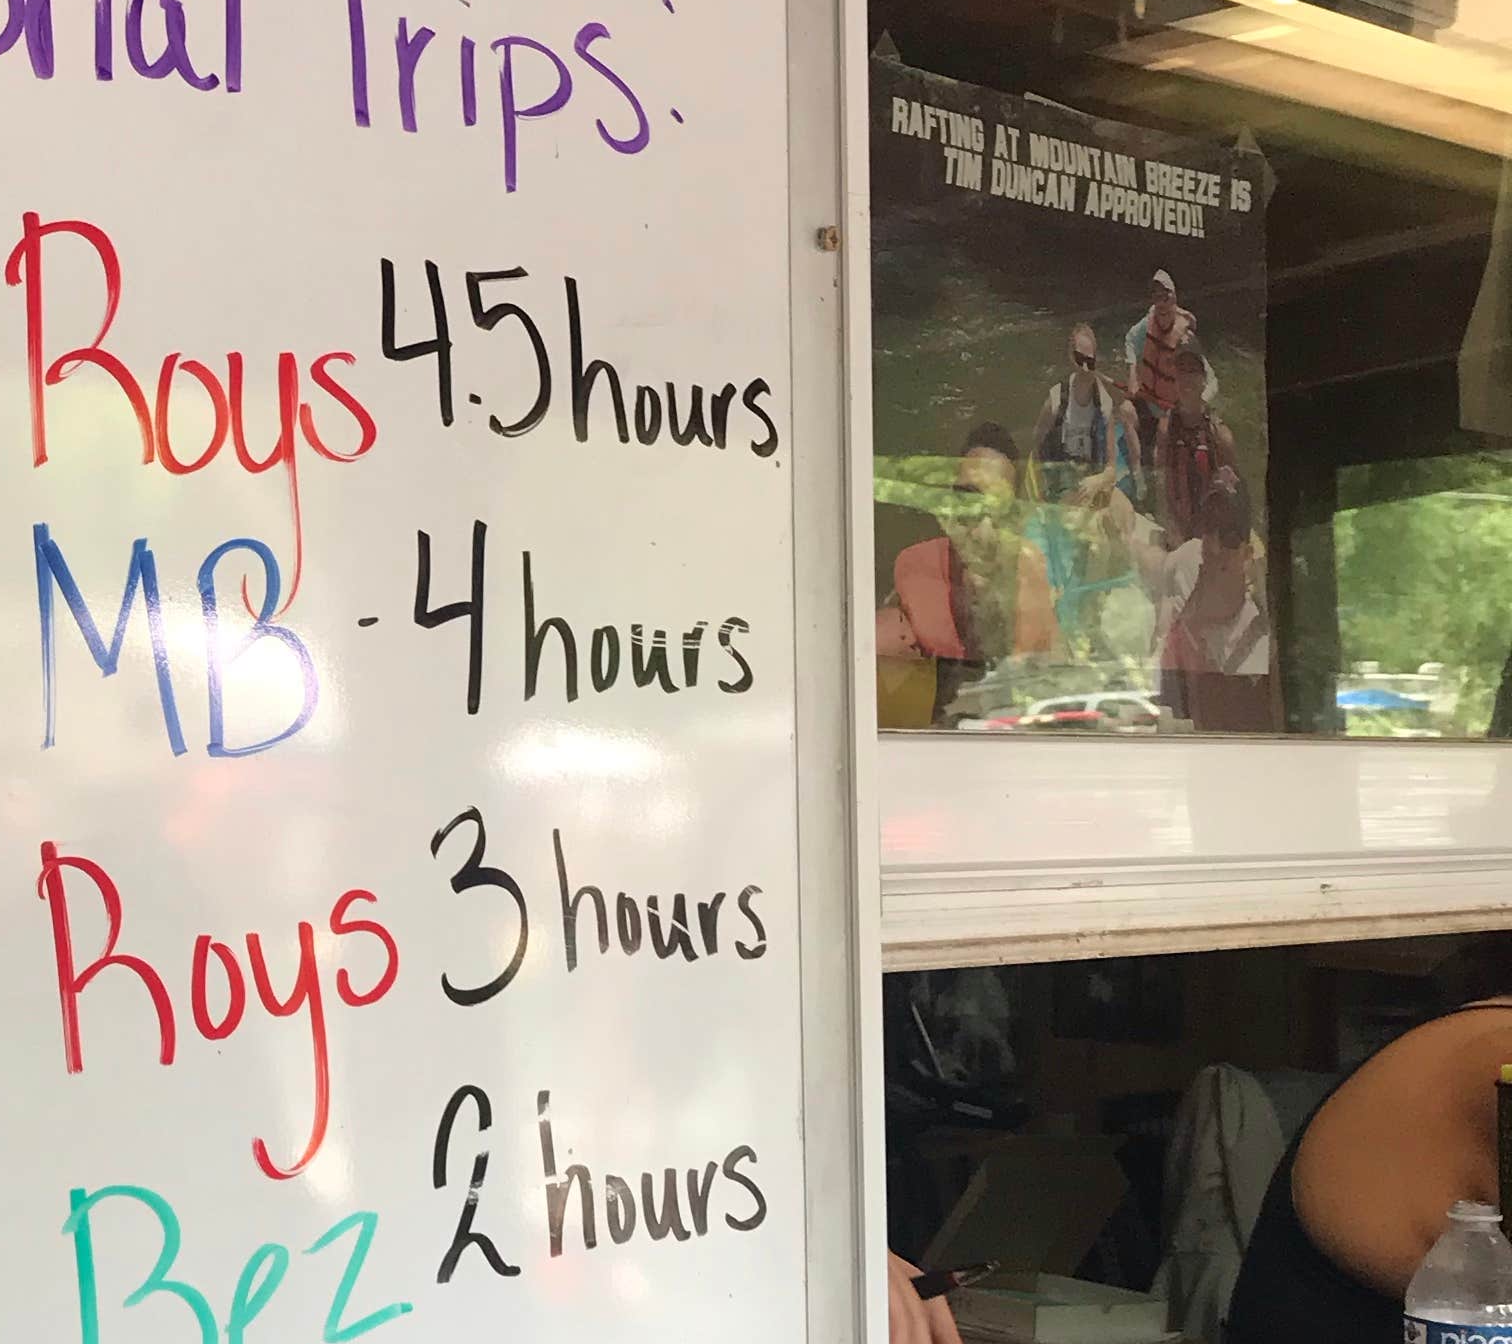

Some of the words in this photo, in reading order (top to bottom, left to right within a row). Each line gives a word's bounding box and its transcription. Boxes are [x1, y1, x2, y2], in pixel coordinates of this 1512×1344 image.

[892, 96, 985, 153] RAFTING
[994, 123, 1020, 162] AT
[1029, 132, 1138, 189] MOUNTAIN
[1144, 160, 1221, 207] BREEZE
[1230, 177, 1252, 213] IS
[944, 146, 983, 191] TIM
[990, 158, 1076, 212] DUNCAN
[1084, 181, 1205, 239] APPROVED!!
[4, 210, 379, 619] Roys
[34, 522, 320, 759] MB
[413, 519, 488, 715] 4
[522, 550, 755, 703] hours
[37, 840, 401, 1181] Roys
[430, 805, 530, 1008] 3
[550, 827, 768, 973] hours
[432, 1084, 523, 1286] 2
[538, 1089, 769, 1258] hours
